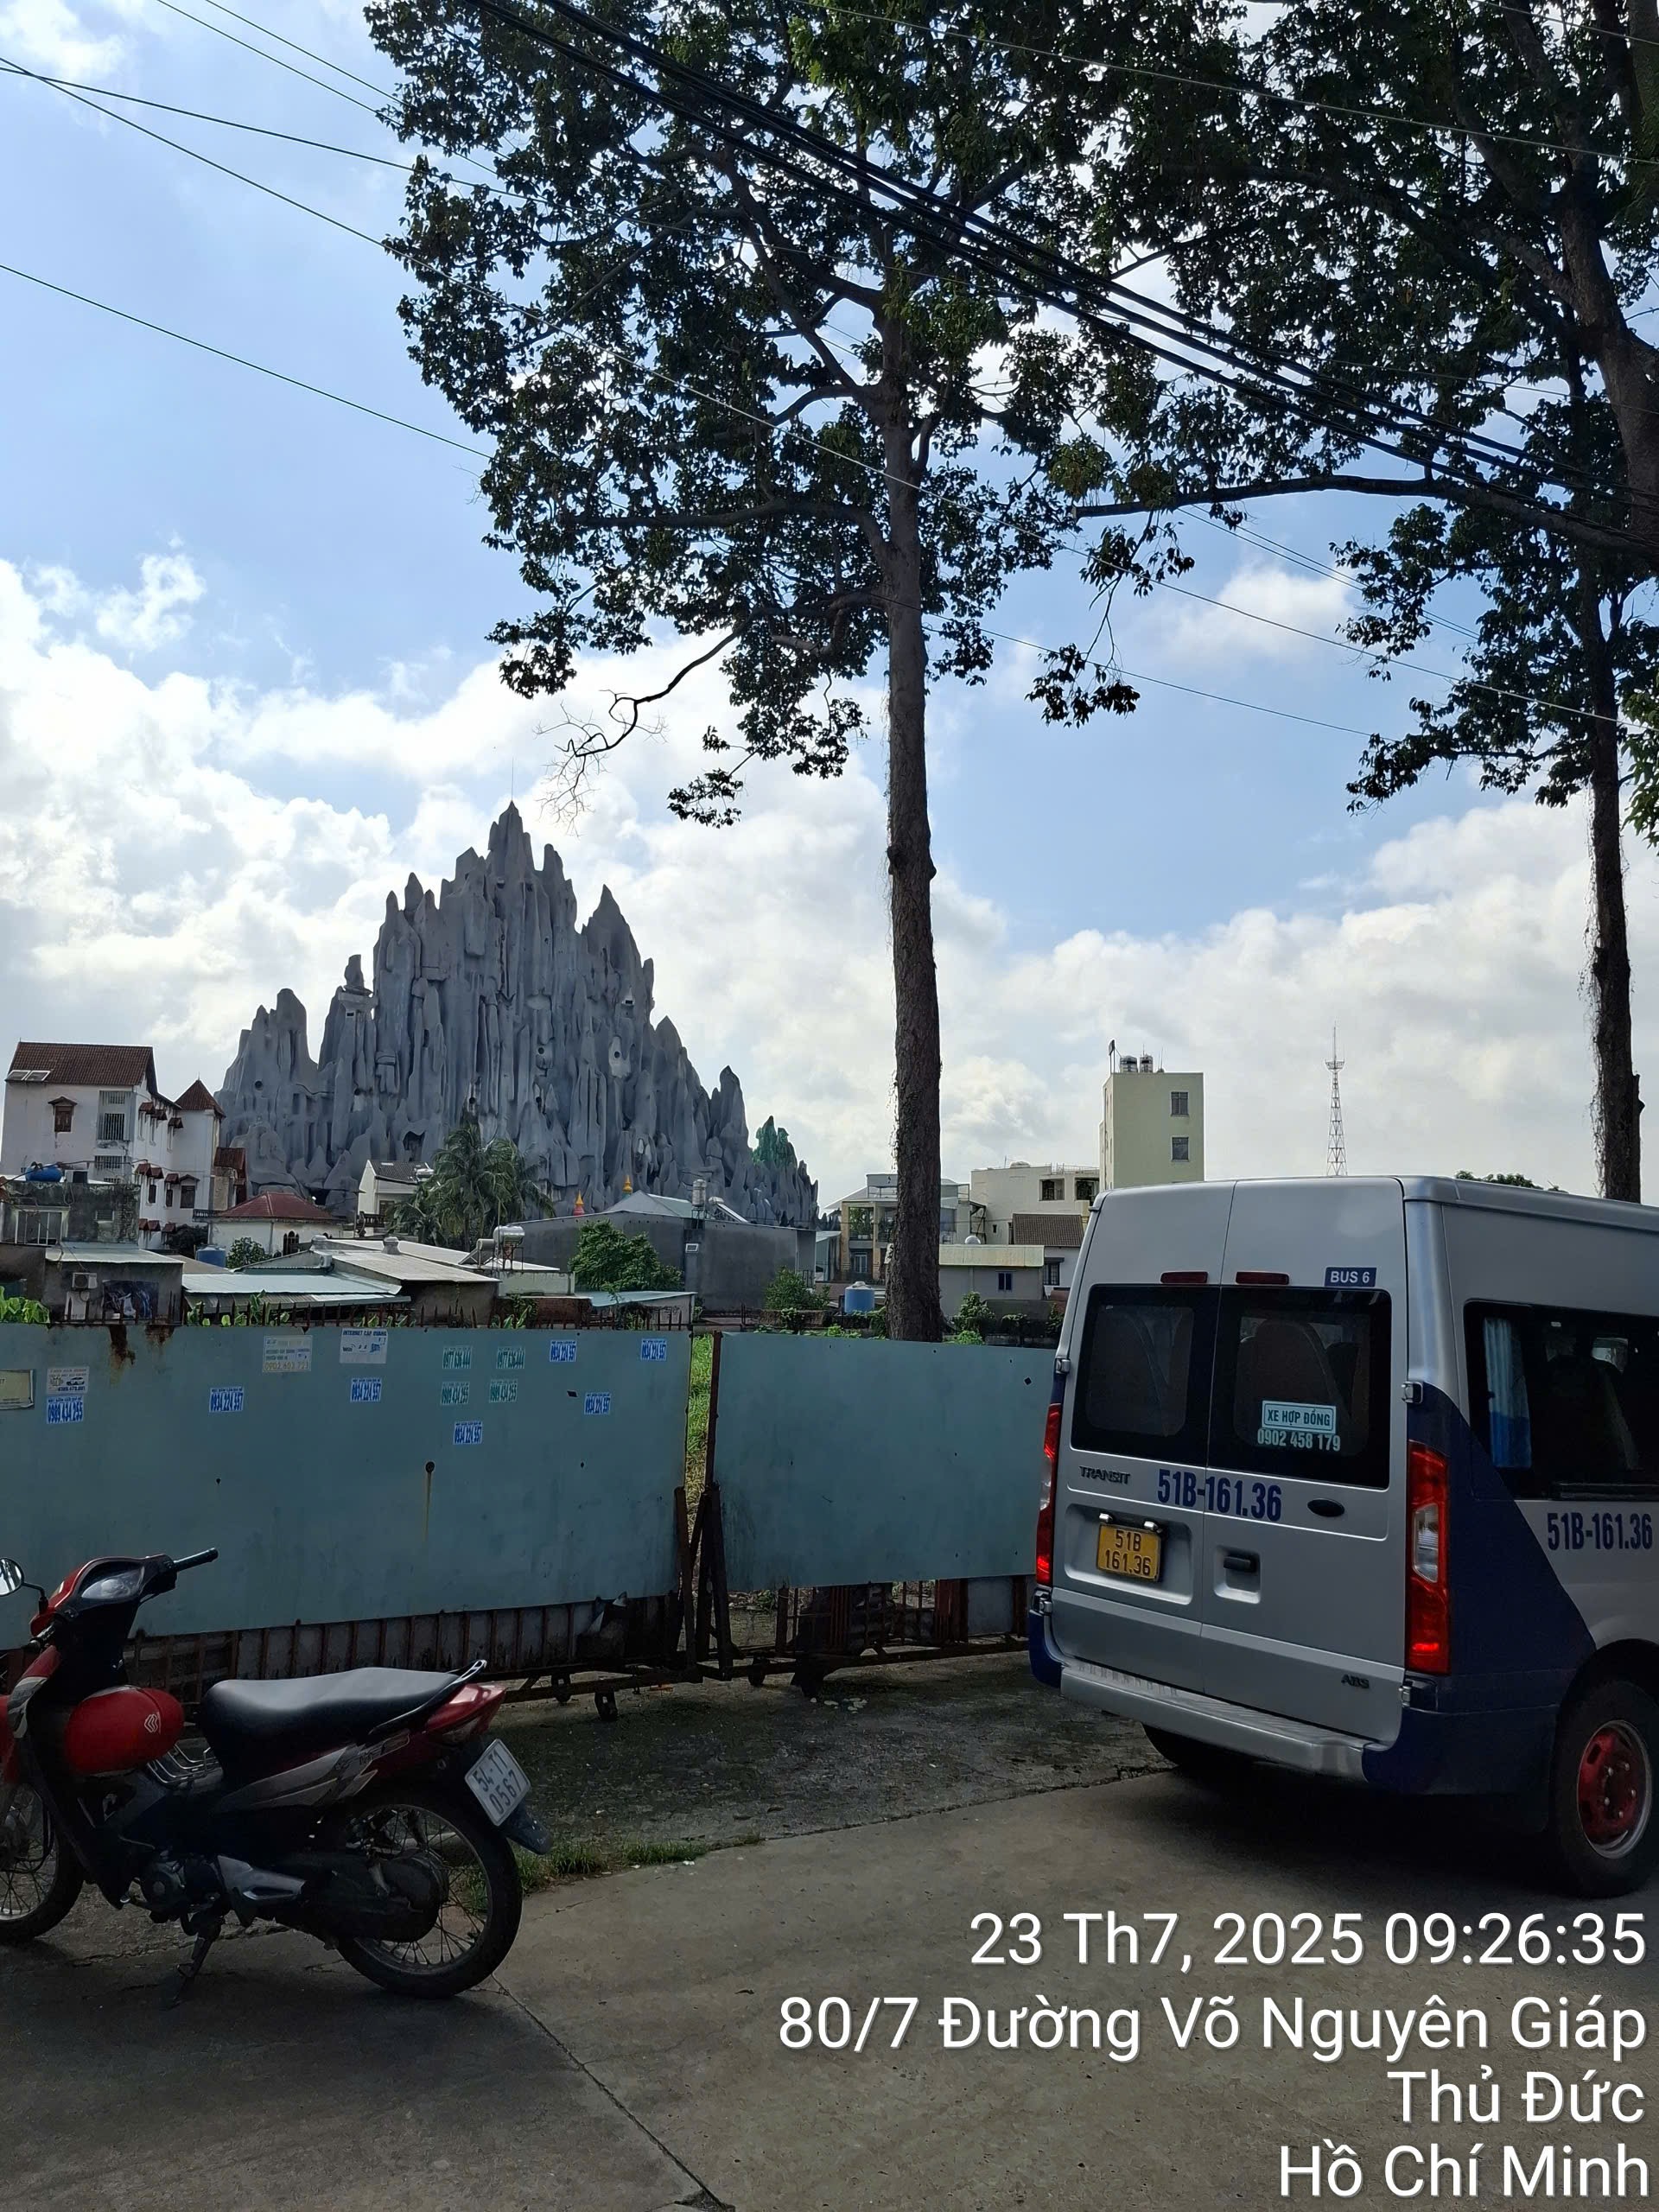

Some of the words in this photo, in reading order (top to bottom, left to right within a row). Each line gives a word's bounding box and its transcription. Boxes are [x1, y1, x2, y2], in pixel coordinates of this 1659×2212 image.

[1331, 1271, 1358, 1283] BUS
[1362, 1272, 1370, 1283] 6
[1268, 1409, 1279, 1421] XE
[1282, 1410, 1300, 1426] HỢP
[1257, 1428, 1287, 1446] 0902
[1290, 1431, 1313, 1449] 458
[1318, 1434, 1341, 1452] 179
[1079, 1466, 1130, 1485] TRANSIT
[1157, 1469, 1282, 1522] 51B-161.36
[1116, 1529, 1141, 1552] 51B
[1547, 1512, 1653, 1550] 51B-161.36
[1105, 1549, 1152, 1576] 161.36
[1341, 1675, 1370, 1689] ABS
[489, 1769, 522, 1815] 0567
